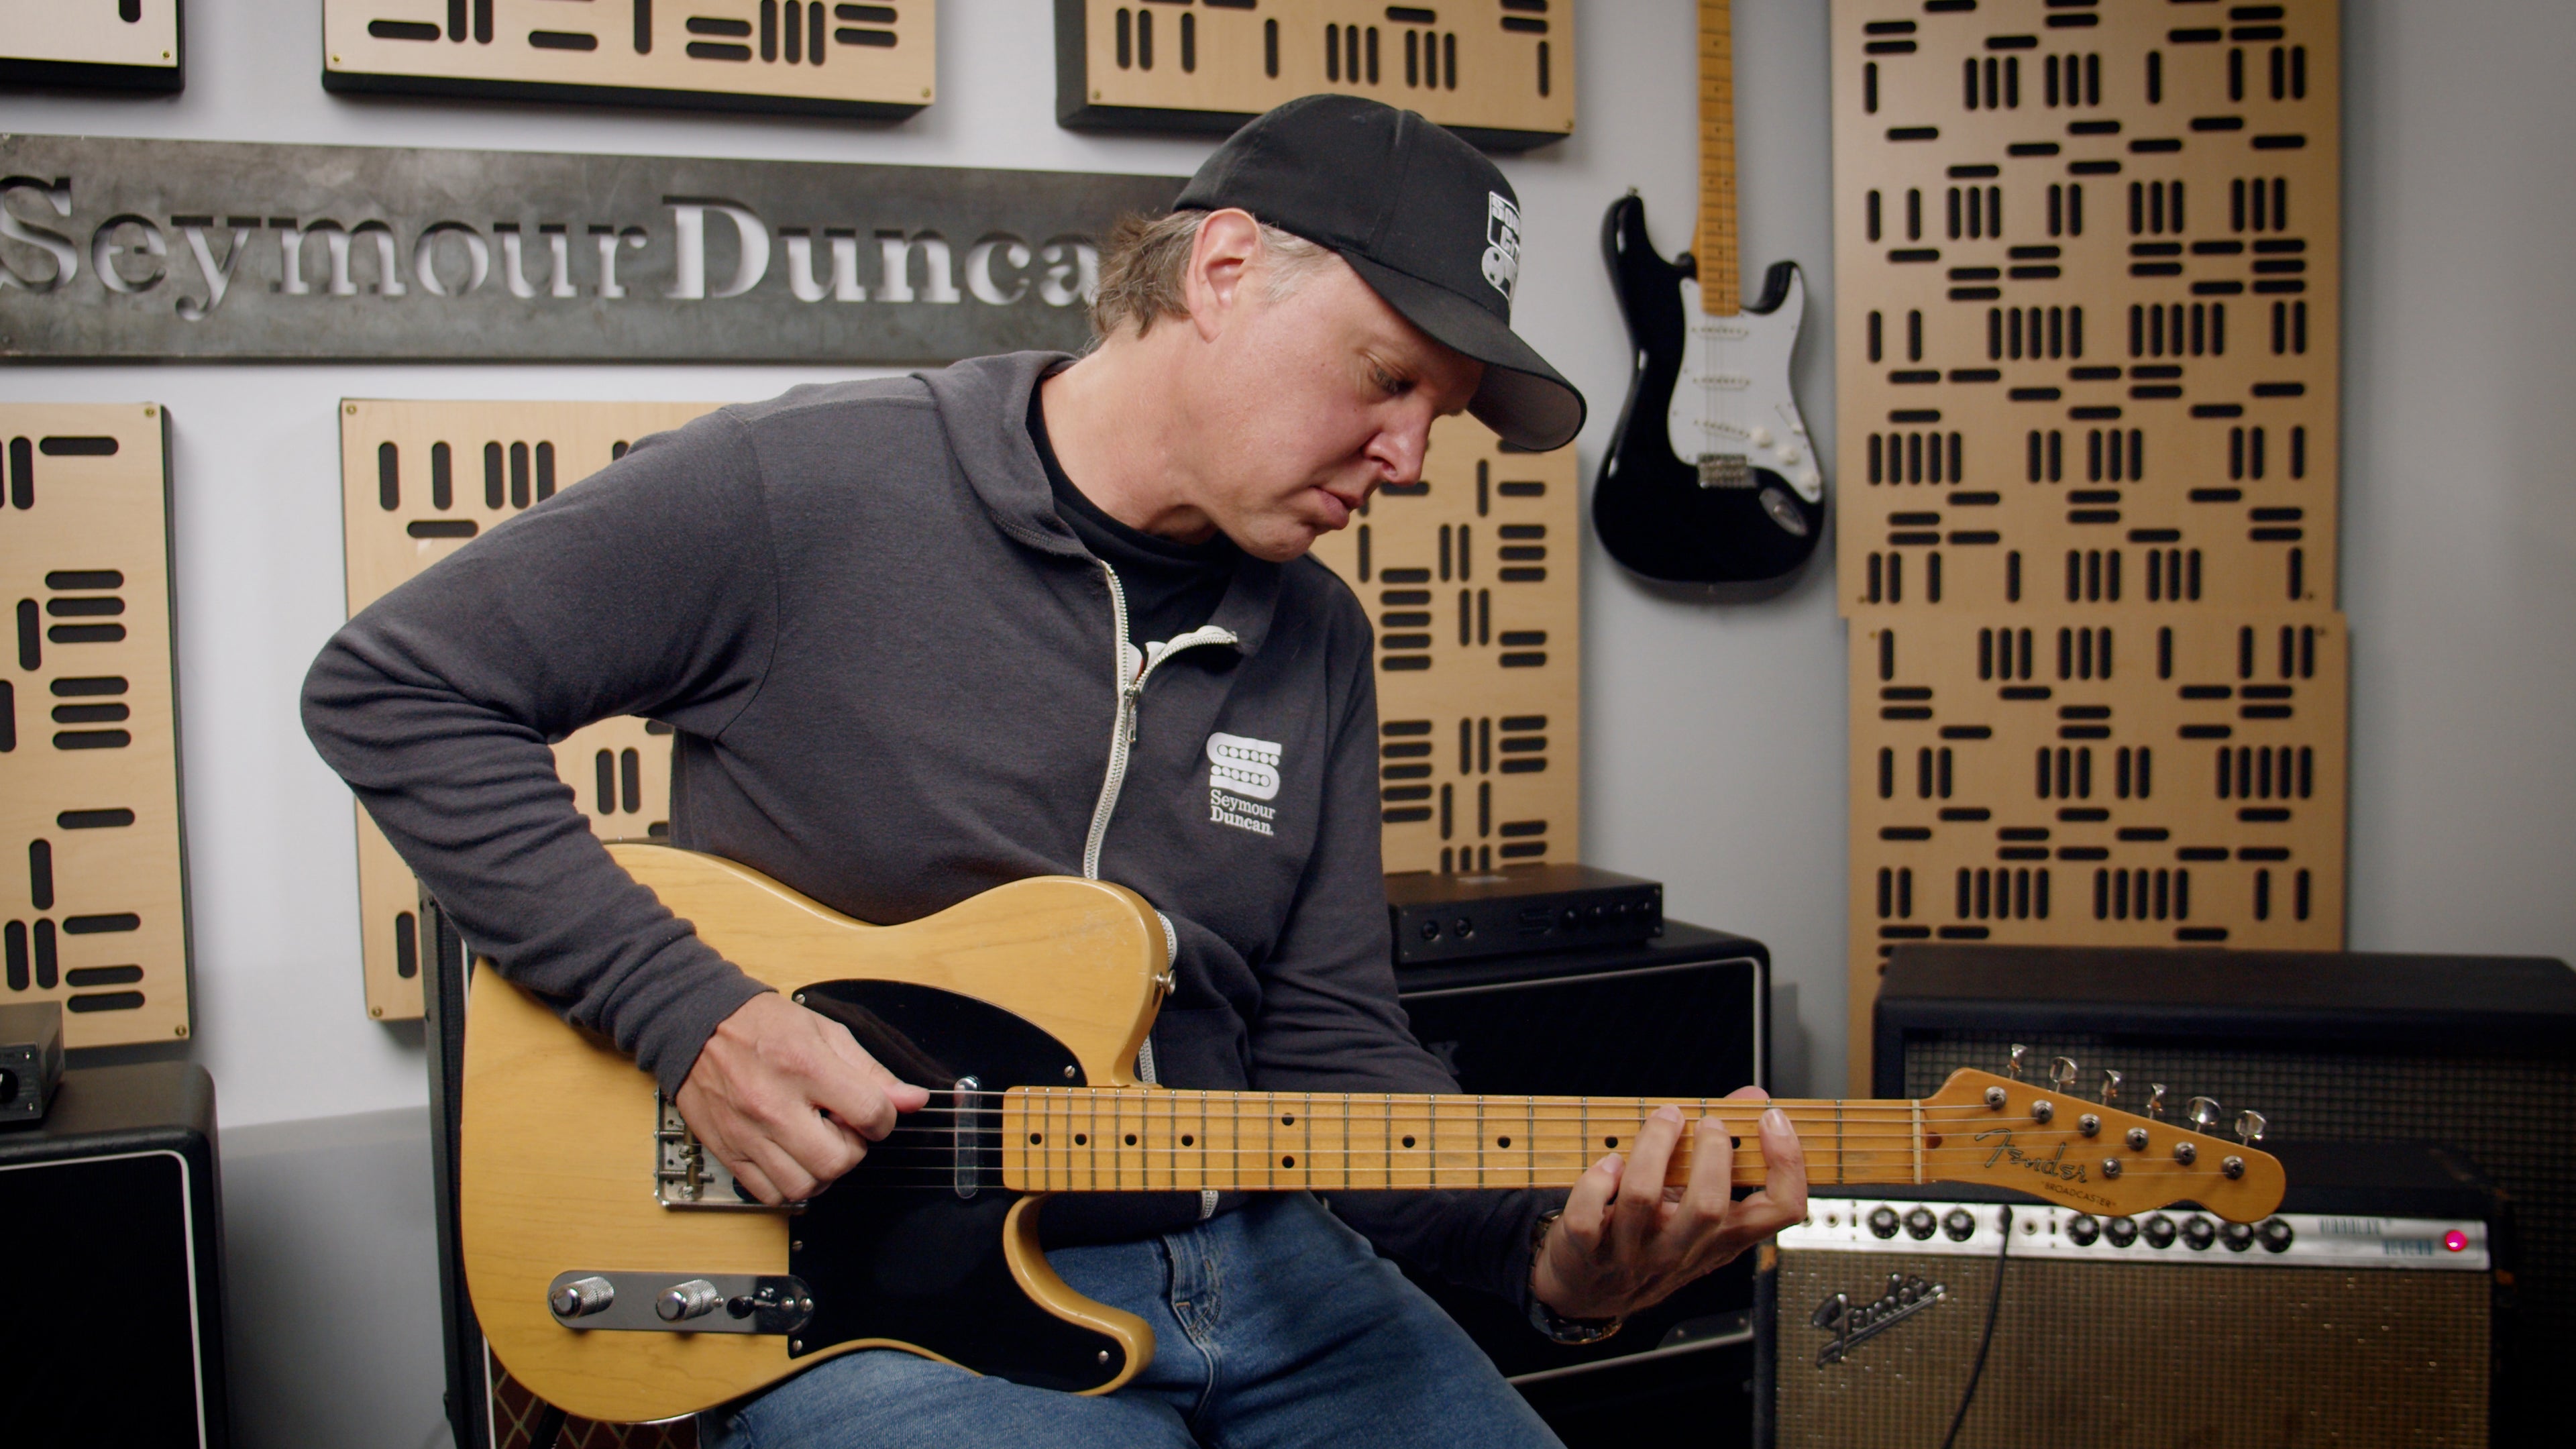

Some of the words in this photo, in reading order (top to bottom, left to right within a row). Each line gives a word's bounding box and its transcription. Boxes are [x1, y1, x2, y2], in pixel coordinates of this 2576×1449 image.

[0, 174, 648, 321] Seymour
[661, 195, 1100, 307] Dunca
[1210, 789, 1276, 820] Seymour
[1974, 1128, 2088, 1183] Fender
